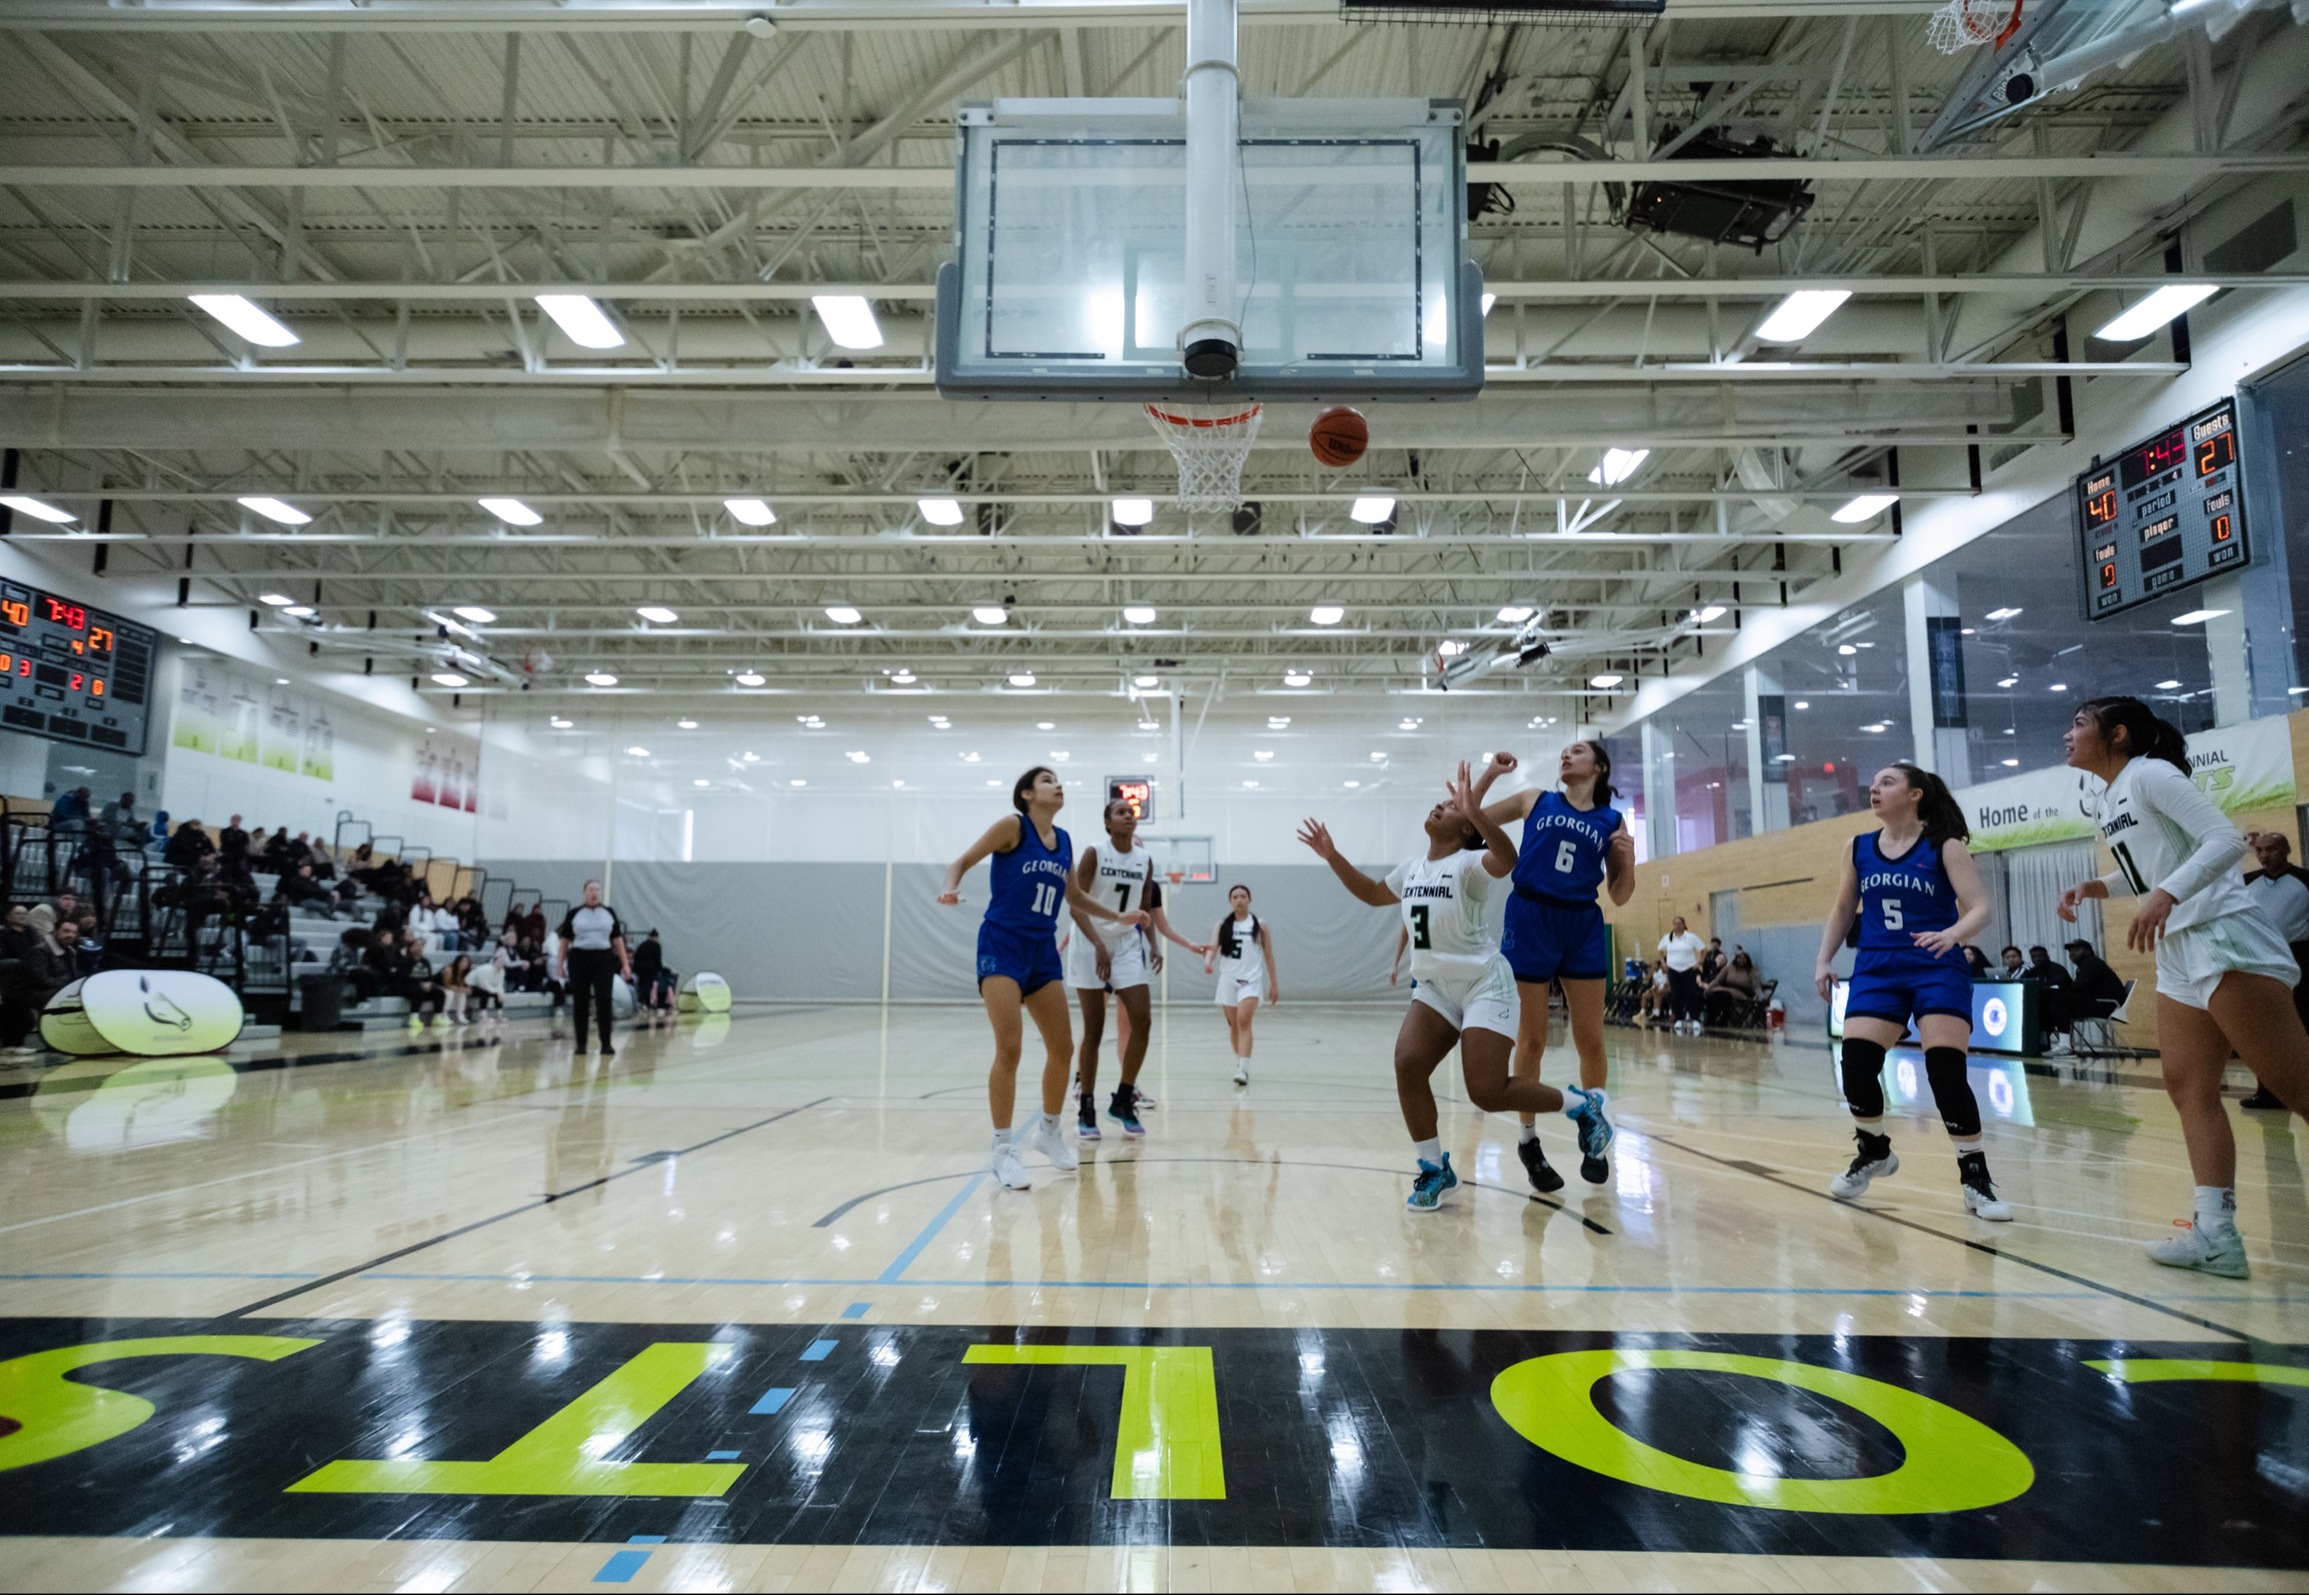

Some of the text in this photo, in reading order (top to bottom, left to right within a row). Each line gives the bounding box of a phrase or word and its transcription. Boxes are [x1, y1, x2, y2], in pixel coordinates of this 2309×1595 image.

[2193, 412, 2230, 441] Guests
[2200, 432, 2234, 475] 27
[2087, 475, 2111, 496] Home
[2172, 471, 2178, 480] 4
[2089, 489, 2118, 523] 40
[2141, 492, 2172, 519] period
[2206, 493, 2231, 513] fouls
[2144, 517, 2174, 542] player
[2216, 515, 2230, 541] 0
[2095, 545, 2116, 562] fouls
[2213, 547, 2234, 564] won
[2151, 569, 2175, 590] game
[2101, 591, 2118, 607] won
[1, 599, 30, 627] 40
[45, 598, 86, 631] 7:43
[71, 639, 85, 656] 4
[88, 626, 114, 652] 27
[19, 659, 32, 678] 3
[70, 673, 84, 692] 2
[2186, 749, 2229, 769] NNIAL
[2193, 765, 2236, 793] TS
[1979, 804, 2059, 829] Home of the
[1536, 814, 1605, 853] GEORGIAN
[1555, 840, 1577, 874] 6
[2110, 840, 2151, 898] 11
[1022, 860, 1068, 882] GEORGIA
[1860, 872, 1935, 897] GEORGIAN
[1031, 881, 1057, 917] 10
[1114, 883, 1131, 913] 7
[1410, 904, 1432, 950] 3
[1882, 898, 1904, 931] 5
[0, 1336, 2309, 1517] OLTS
